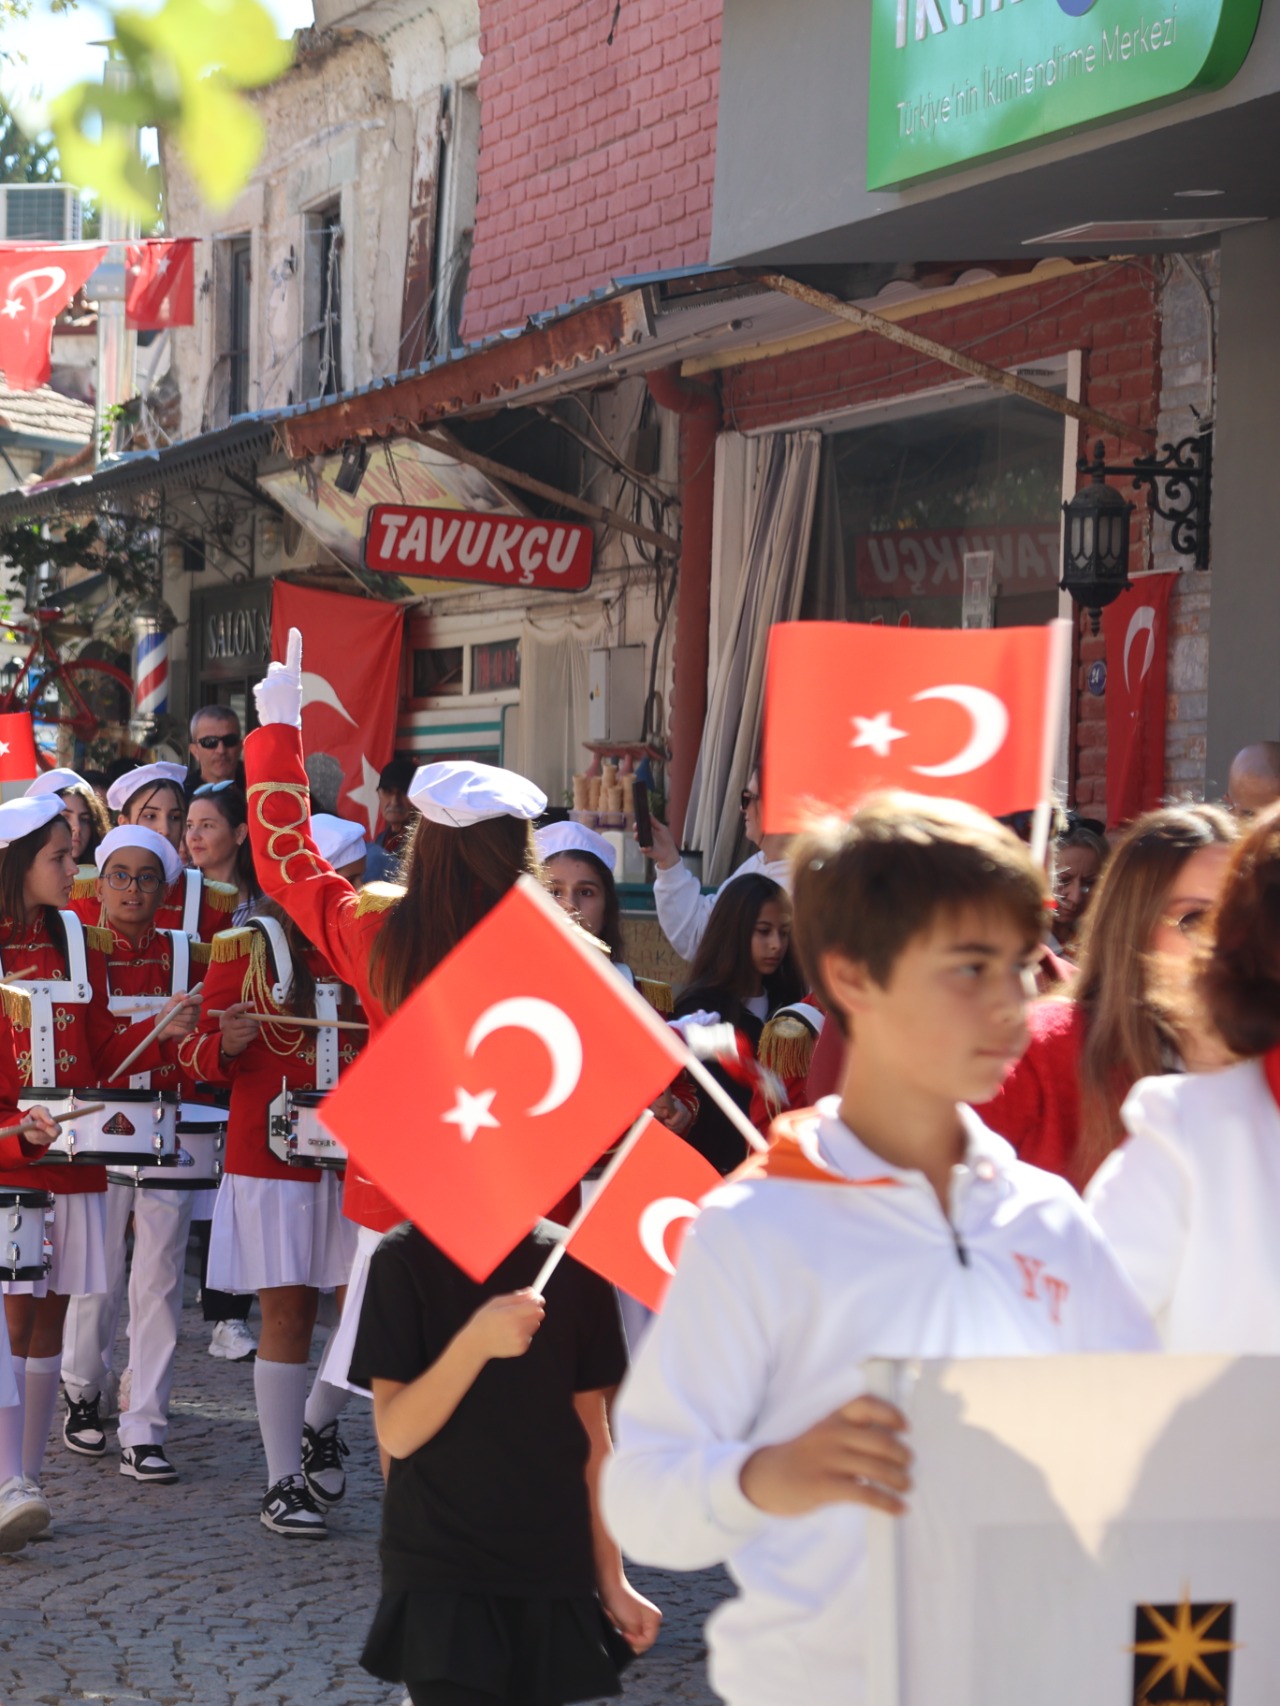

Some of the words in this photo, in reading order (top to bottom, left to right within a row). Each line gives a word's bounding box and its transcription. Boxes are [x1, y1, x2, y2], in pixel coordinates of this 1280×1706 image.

[897, 79, 978, 137] Türkiye'nin
[983, 43, 1096, 109] İklimlendirme
[1101, 4, 1177, 67] Merkezi
[379, 513, 582, 585] TAVUKÇU
[208, 608, 257, 658] SALON
